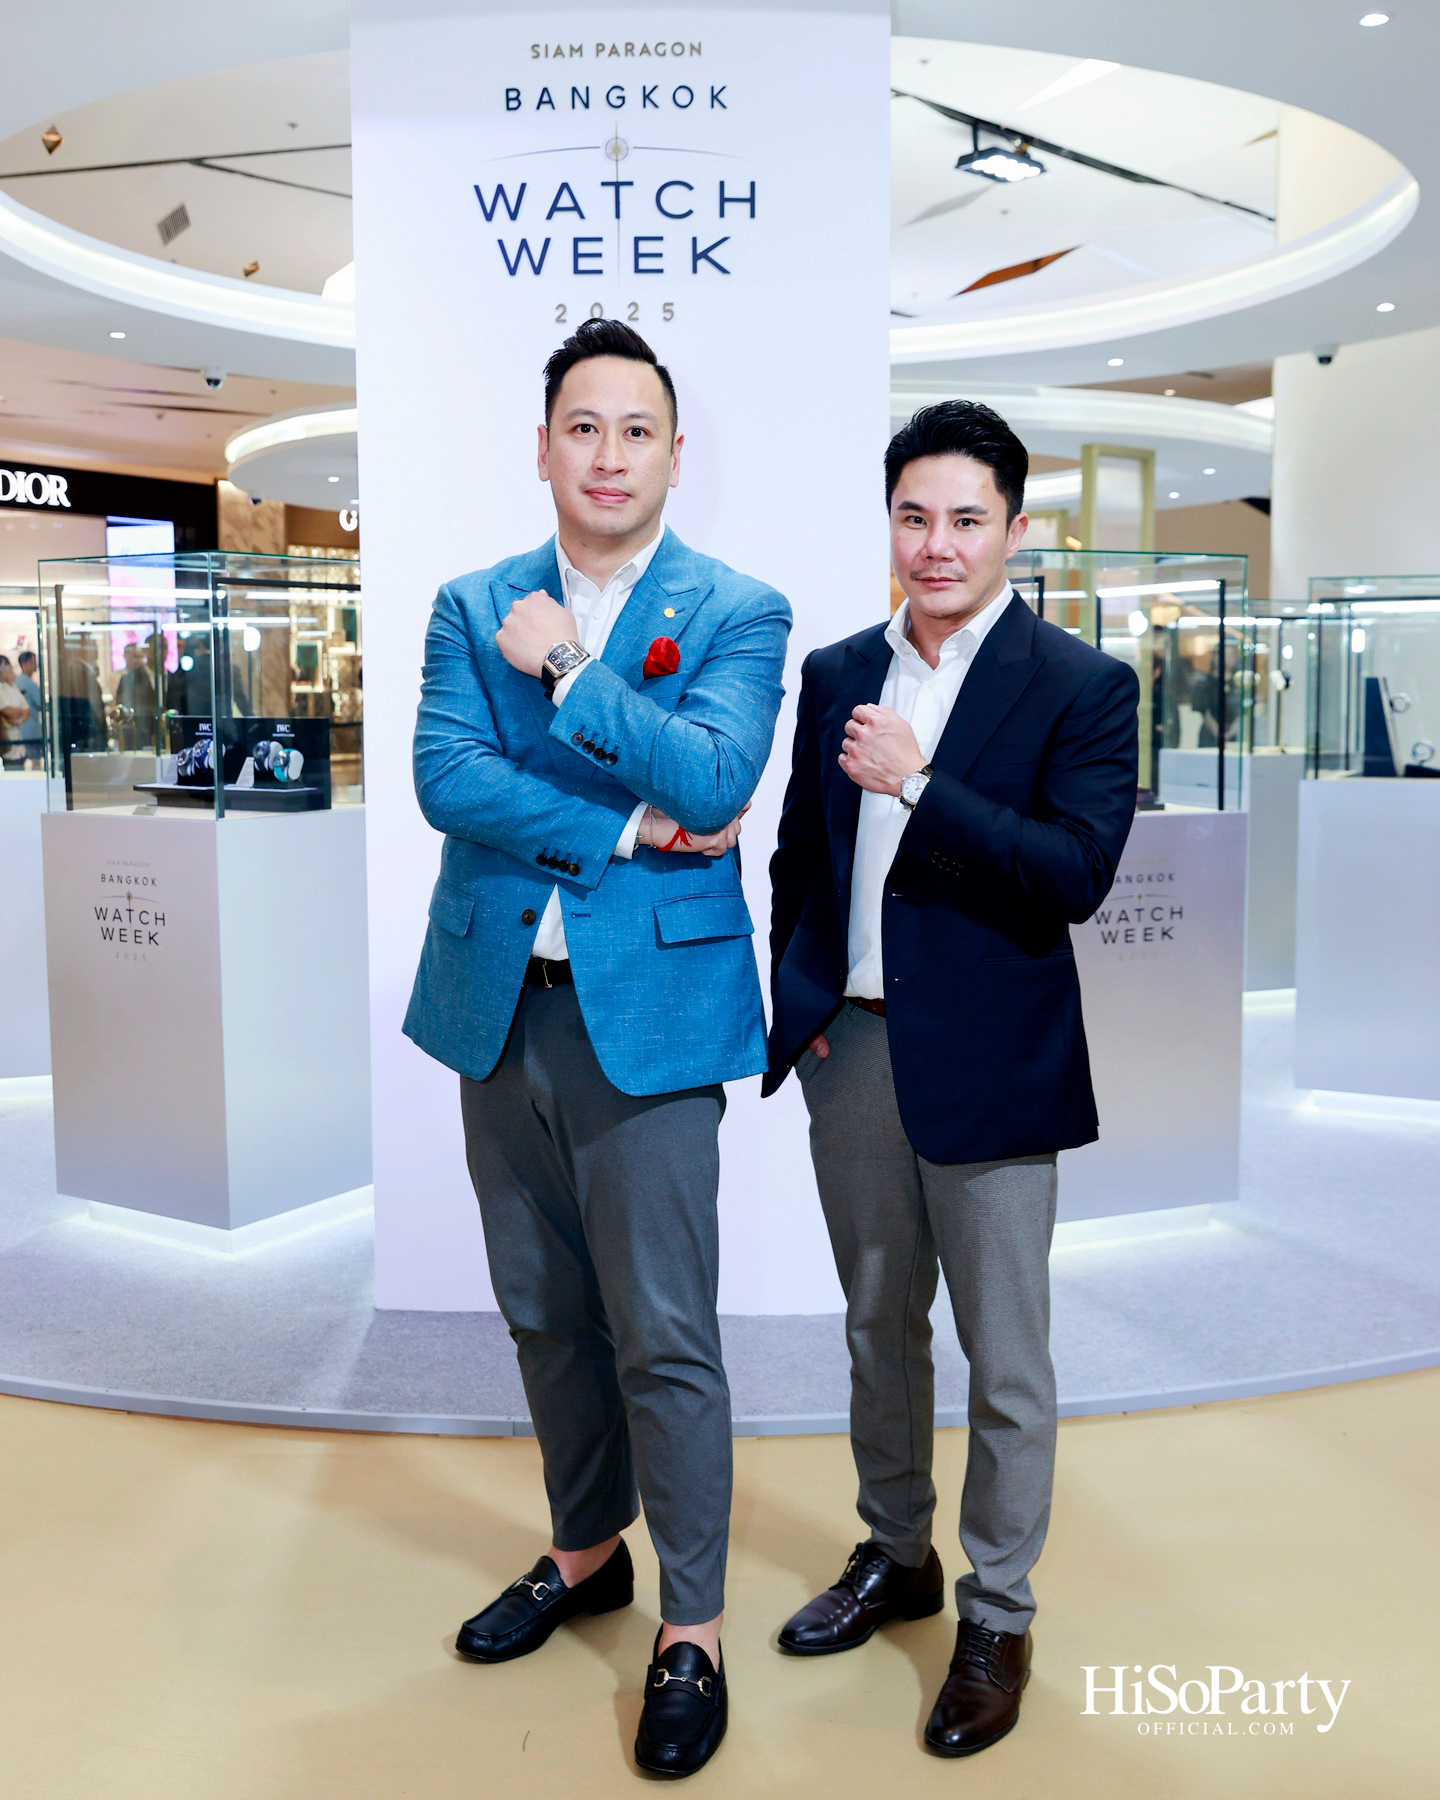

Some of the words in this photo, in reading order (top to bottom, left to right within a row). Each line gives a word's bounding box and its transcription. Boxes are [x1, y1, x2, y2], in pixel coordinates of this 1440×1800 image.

[531, 43, 584, 59] SIAM
[595, 42, 703, 57] PARAGON
[505, 85, 728, 111] BANGKOK
[473, 180, 756, 222] WATCH
[497, 236, 732, 276] WEEK
[555, 302, 675, 323] 2025
[0, 469, 72, 508] DIOR
[198, 722, 212, 732] IWC
[276, 723, 291, 733] IWC
[101, 873, 157, 887] BANGKOK
[1114, 872, 1176, 884] ANGKOK
[94, 906, 166, 927] WATCH
[1094, 906, 1184, 925] WATCH
[101, 926, 159, 946] WEEK
[1101, 926, 1174, 944] WEEK
